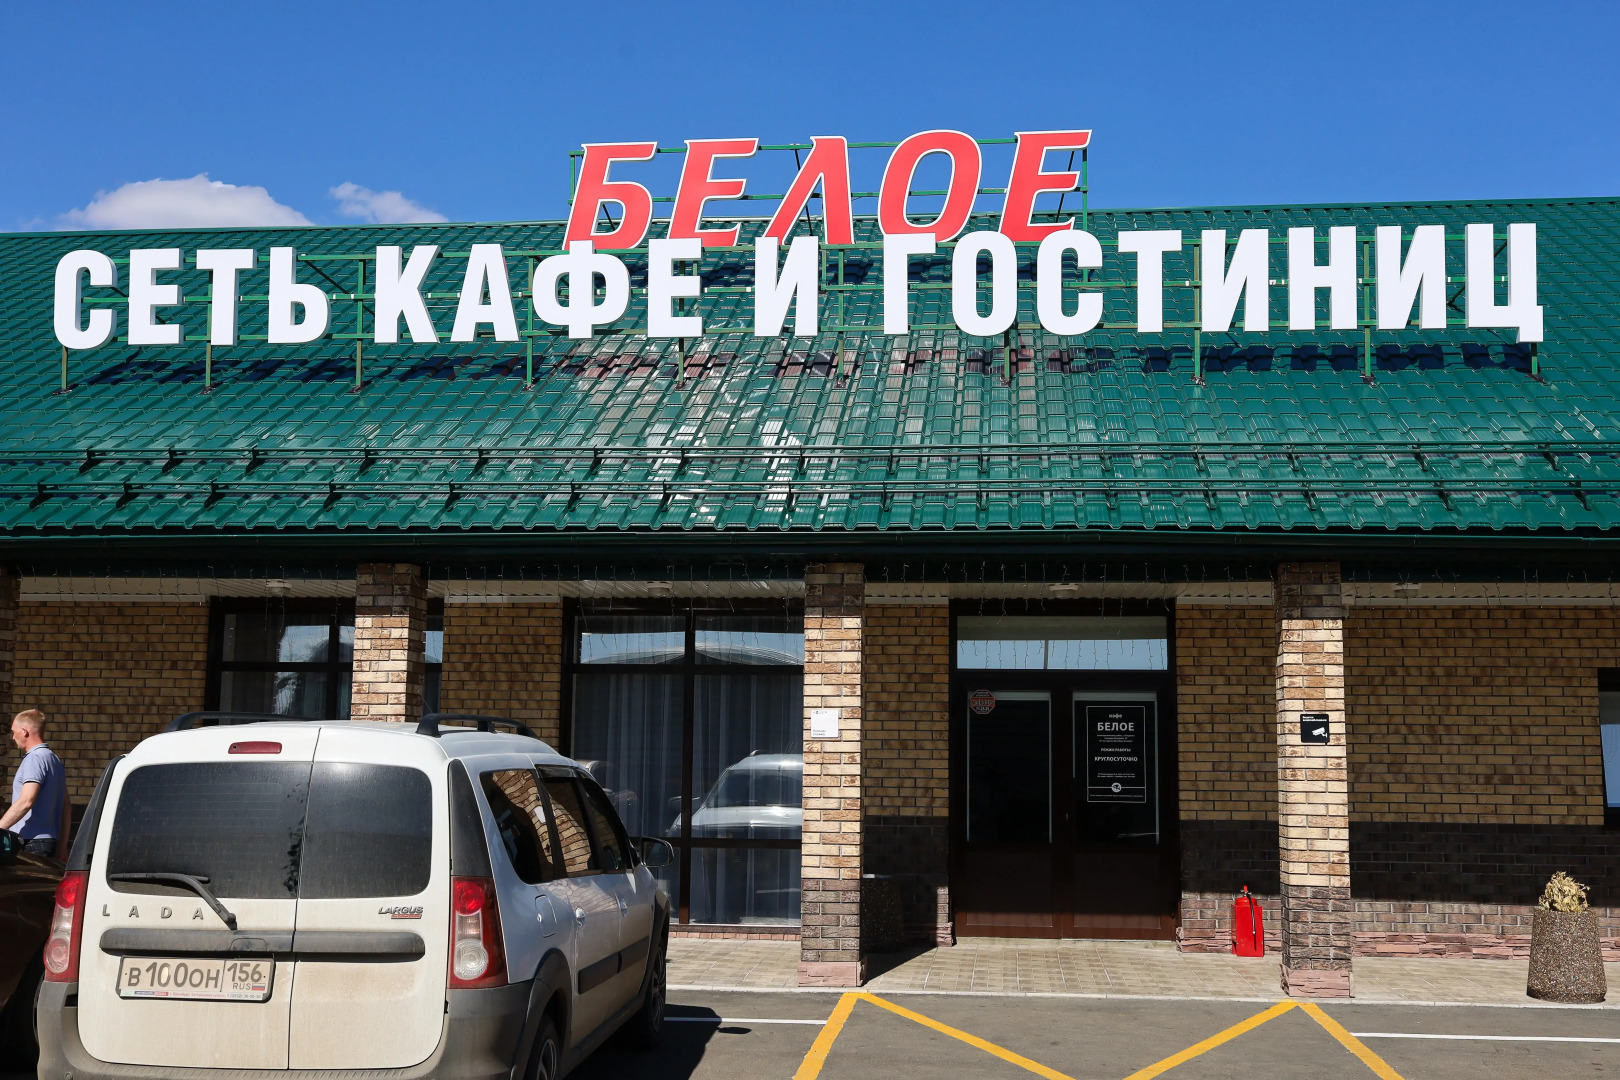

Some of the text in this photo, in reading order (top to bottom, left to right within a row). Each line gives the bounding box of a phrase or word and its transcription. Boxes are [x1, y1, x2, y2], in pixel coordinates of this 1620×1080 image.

[561, 128, 1092, 251] БЕЛОЕ
[53, 222, 1544, 350] СЕТЬ КАФЕ И ГОСТИНИЦ
[1097, 722, 1135, 731] БЕЛОЕ
[102, 904, 204, 920] LADA
[378, 906, 424, 915] LARGUS
[227, 962, 263, 983] 156
[232, 982, 251, 991] RUS
